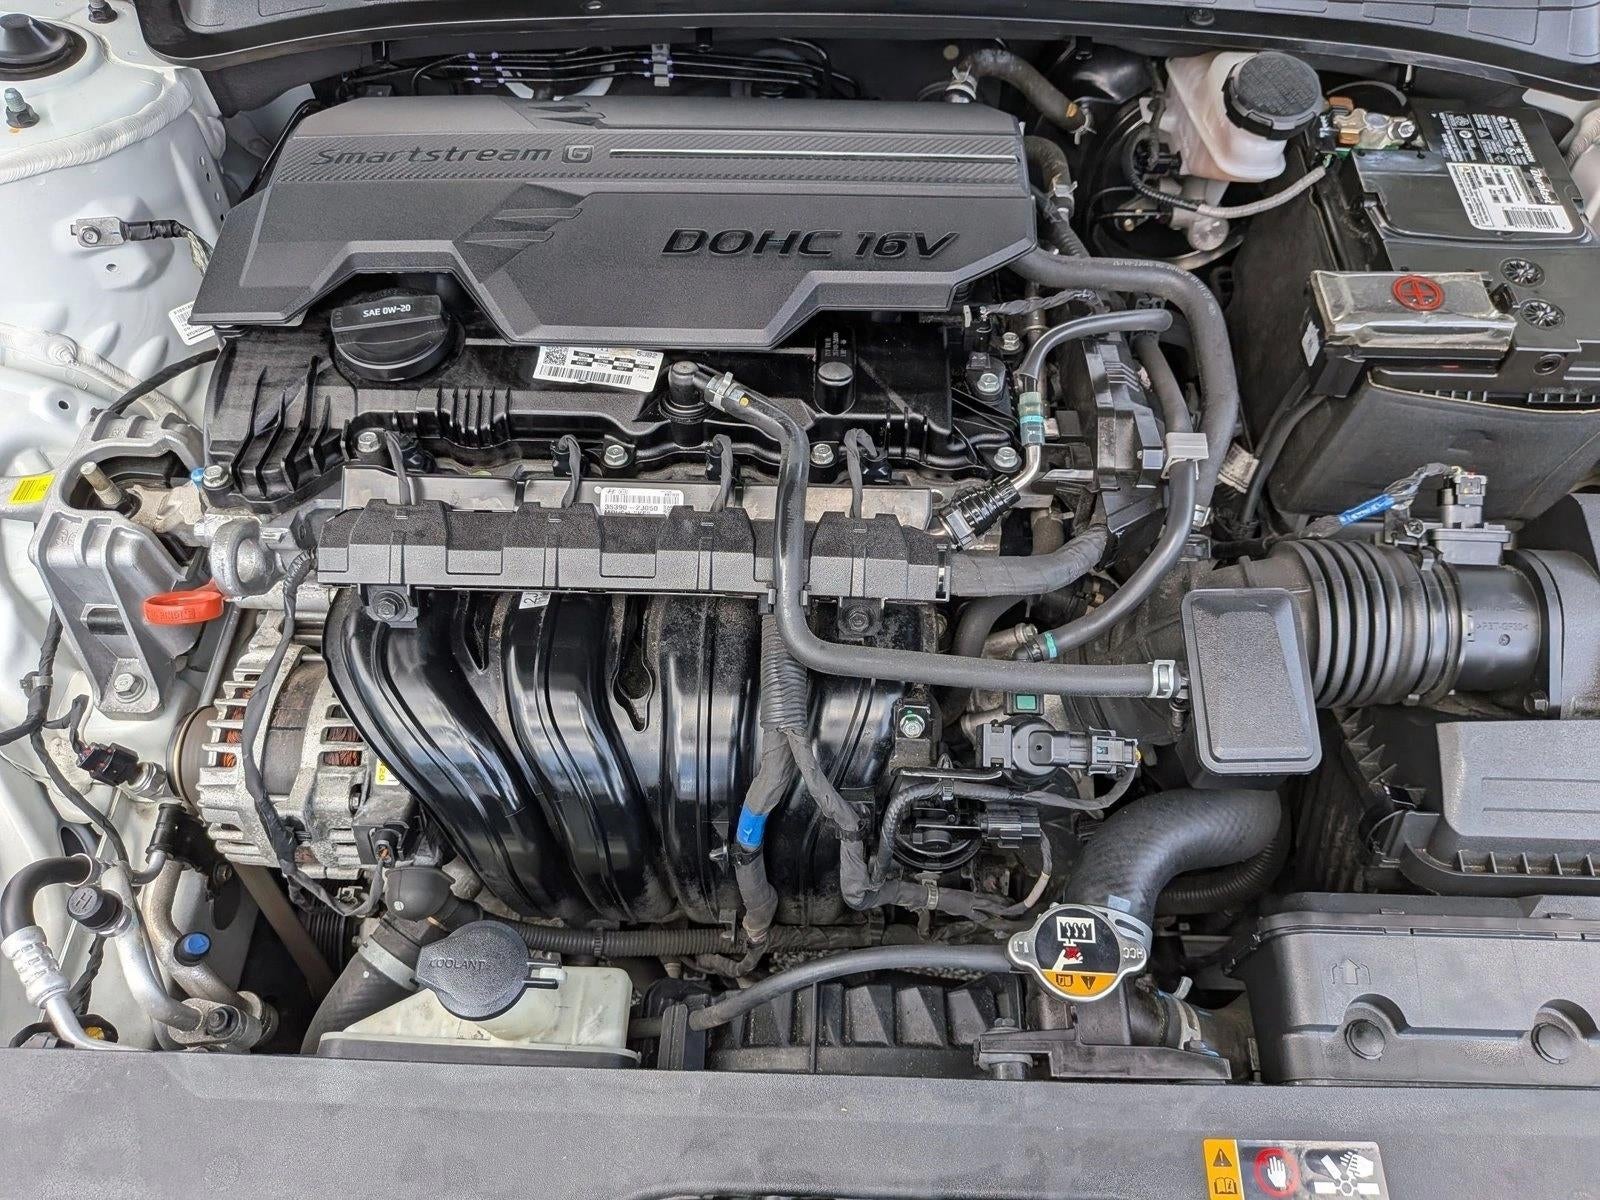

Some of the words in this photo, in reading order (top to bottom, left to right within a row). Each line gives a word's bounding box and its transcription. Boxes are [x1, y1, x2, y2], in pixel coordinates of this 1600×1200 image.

[311, 147, 551, 166] Smartstream
[1530, 168, 1556, 205] Duralast
[661, 228, 843, 257] DOHC
[855, 230, 959, 258] 16V
[362, 307, 381, 318] SAE
[382, 303, 412, 315] 0W-20
[428, 957, 487, 972] COOLANT
